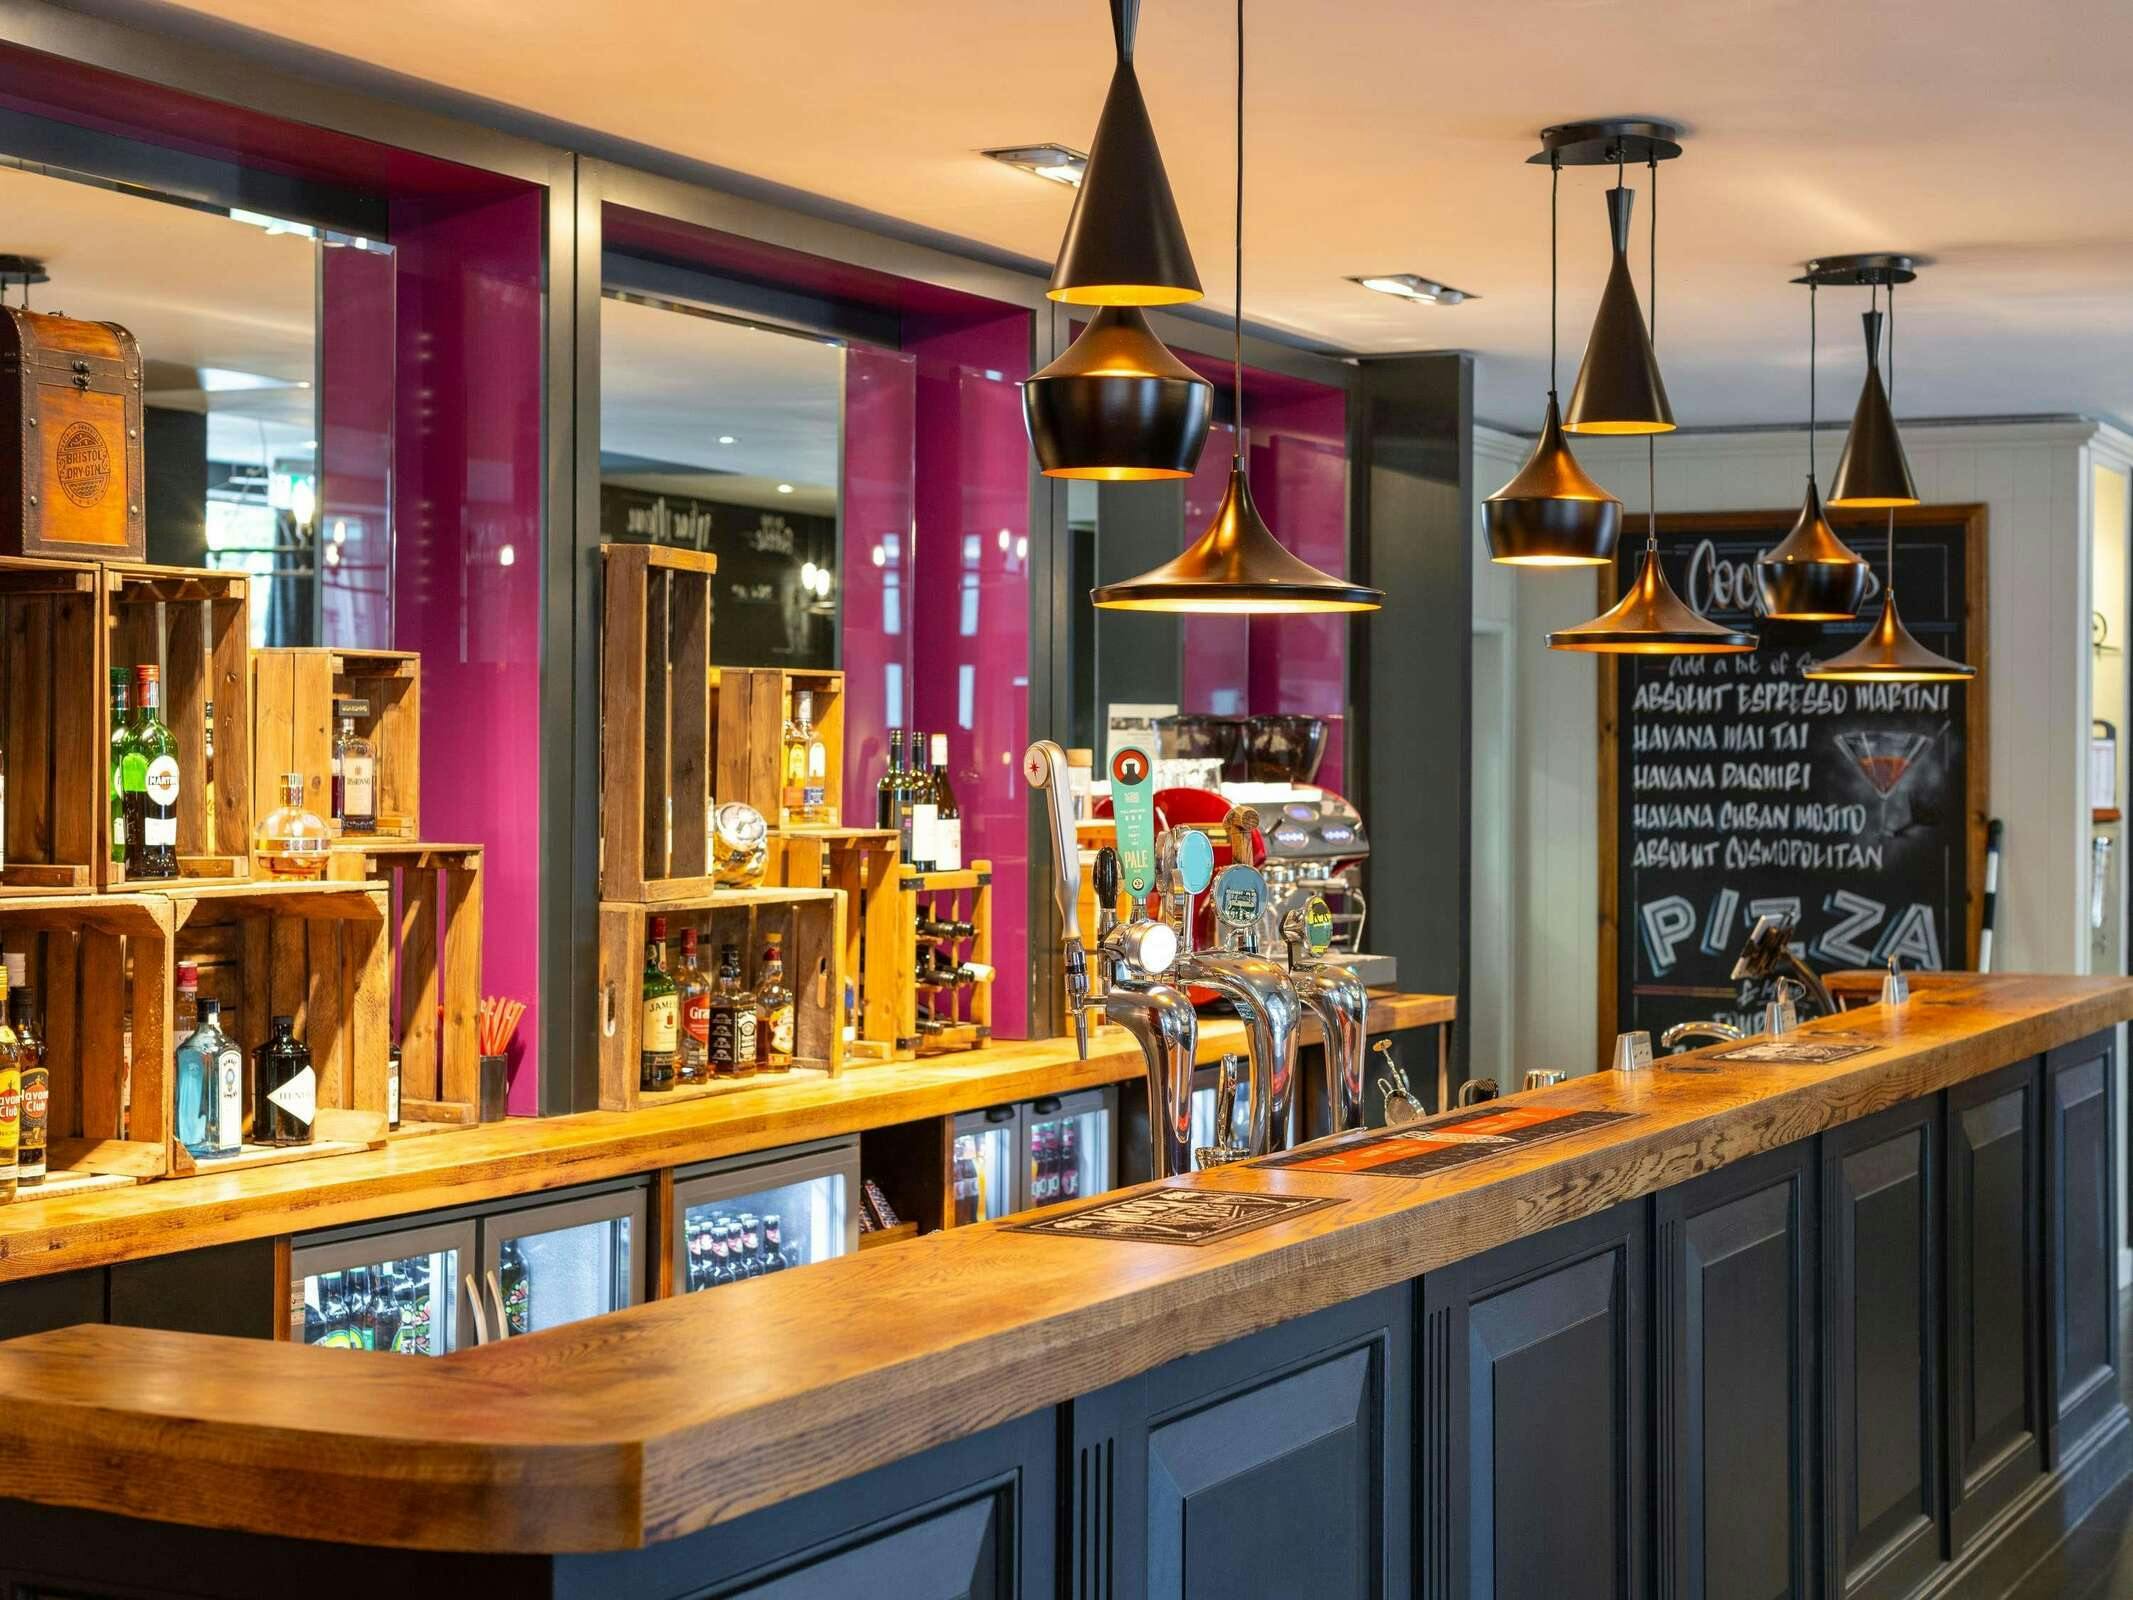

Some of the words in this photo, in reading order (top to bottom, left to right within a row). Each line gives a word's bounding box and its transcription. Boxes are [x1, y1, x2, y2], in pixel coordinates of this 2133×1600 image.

[66, 450, 102, 465] BRISTOL
[66, 466, 83, 480] DRY
[85, 464, 101, 477] GIN
[1668, 655, 1705, 677] Add
[1770, 653, 1791, 675] of
[1633, 683, 1734, 712] ABSOLUT
[1737, 681, 1848, 715] ESPRESSO
[1855, 682, 1951, 713] MARTINI
[1633, 723, 1718, 752] HAVANA
[1723, 723, 1765, 753] MAI
[1770, 721, 1810, 751] TAI
[1633, 763, 1715, 791] HAVANA
[1633, 803, 1714, 831] HAVANA
[1718, 800, 1790, 833] CUBAN
[1794, 803, 1867, 834] MOJITO
[1124, 849, 1149, 870] PALE
[1633, 838, 1719, 868] ABSOLUT
[1725, 837, 1884, 869] COSMOPOLITAN
[0, 1105, 18, 1118] Club
[26, 1100, 46, 1113] Club
